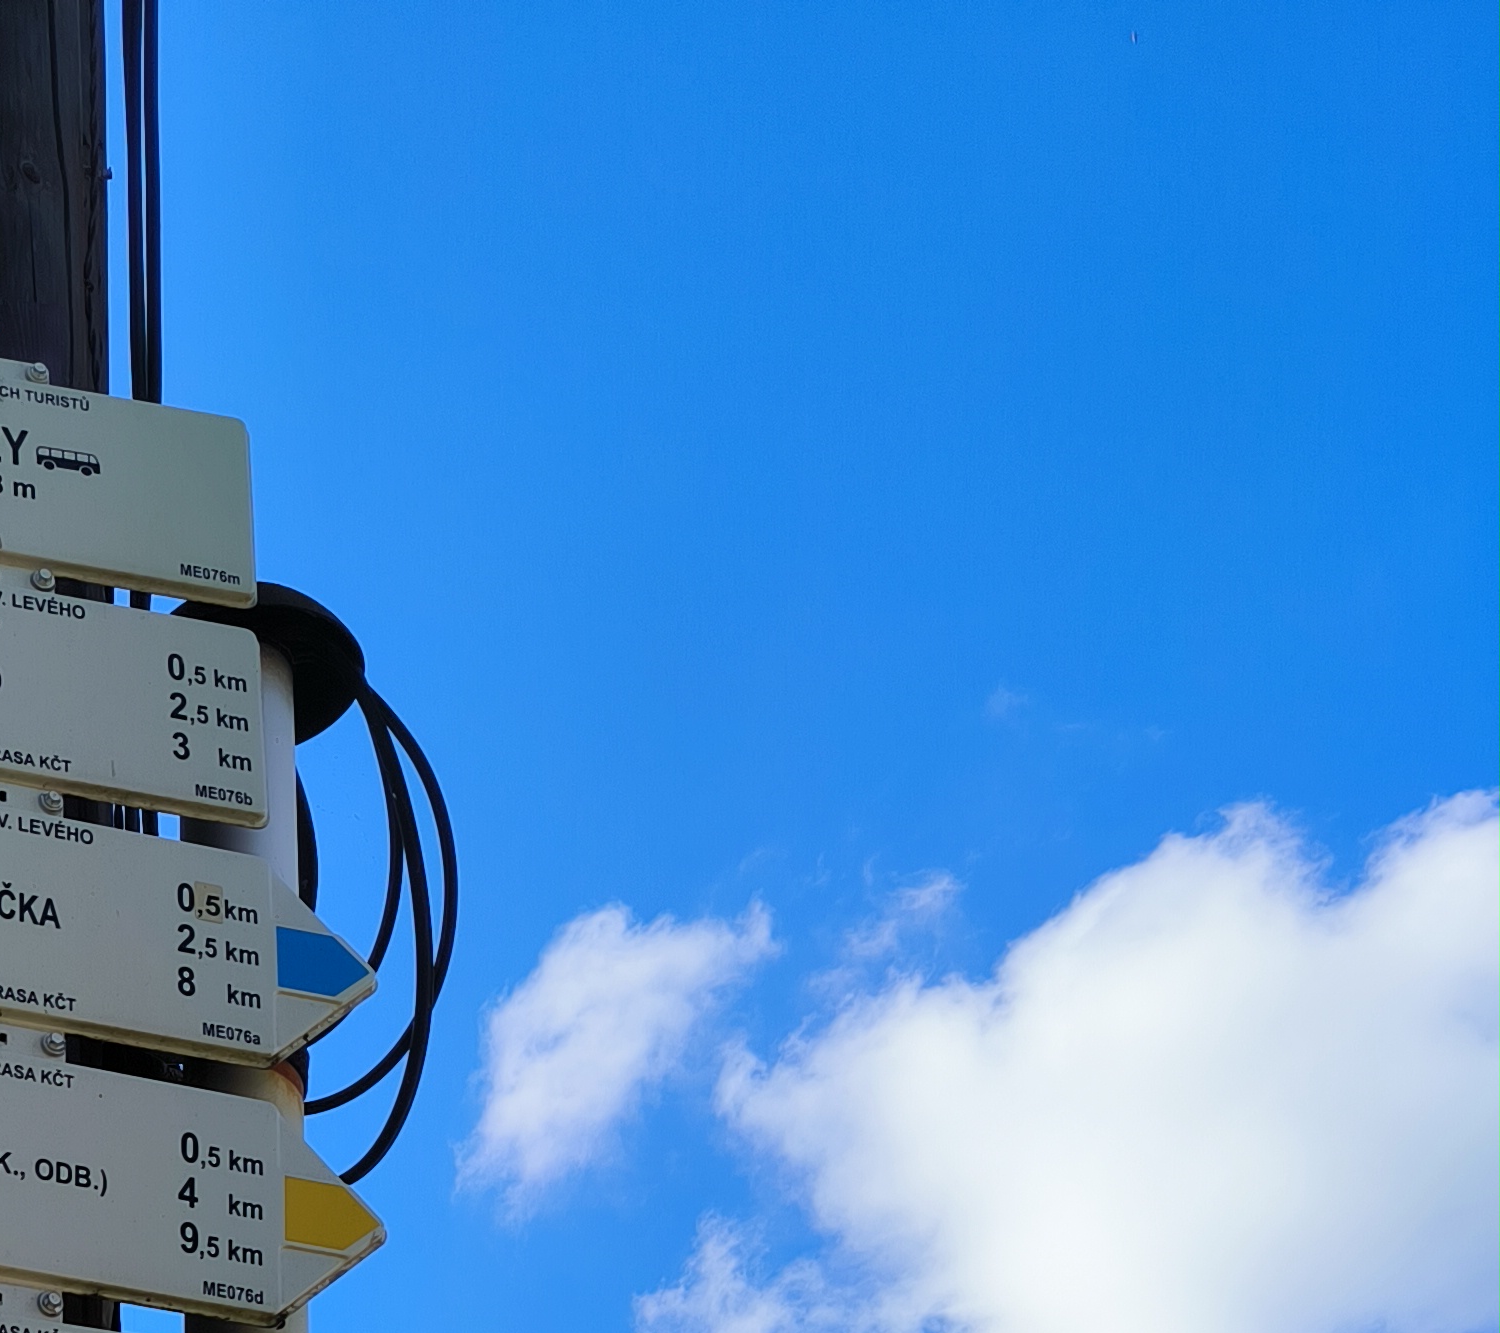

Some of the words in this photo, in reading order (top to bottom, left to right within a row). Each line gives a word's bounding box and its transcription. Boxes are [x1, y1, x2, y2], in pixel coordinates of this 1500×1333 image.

[25, 389, 89, 411] TURISTŮ
[13, 481, 35, 499] m
[180, 563, 240, 585] ME076m
[12, 594, 86, 620] LEVÉHO
[167, 653, 207, 687] 0,5
[214, 669, 247, 693] km
[170, 692, 208, 726] 2,5
[217, 708, 249, 732] km
[39, 752, 71, 773] KČT
[172, 732, 190, 760] 3
[219, 748, 252, 772] km
[195, 784, 253, 807] ME076b
[18, 816, 94, 845] LEVÉHO
[177, 882, 221, 919] 0,5
[224, 899, 258, 925] km
[177, 924, 218, 960] 2,5
[225, 941, 259, 966] km
[43, 992, 77, 1012] KČT
[177, 967, 196, 997] 8
[227, 984, 261, 1009] km
[202, 1023, 261, 1046] ME076a
[40, 1068, 74, 1088] KČT
[180, 1132, 221, 1170] 0,5
[229, 1150, 264, 1176] km
[35, 1158, 108, 1197] ODB.)
[178, 1177, 198, 1208] 4
[229, 1194, 263, 1220] km
[180, 1222, 220, 1260] 9,5
[228, 1240, 263, 1266] km
[203, 1281, 264, 1305] ME076d
